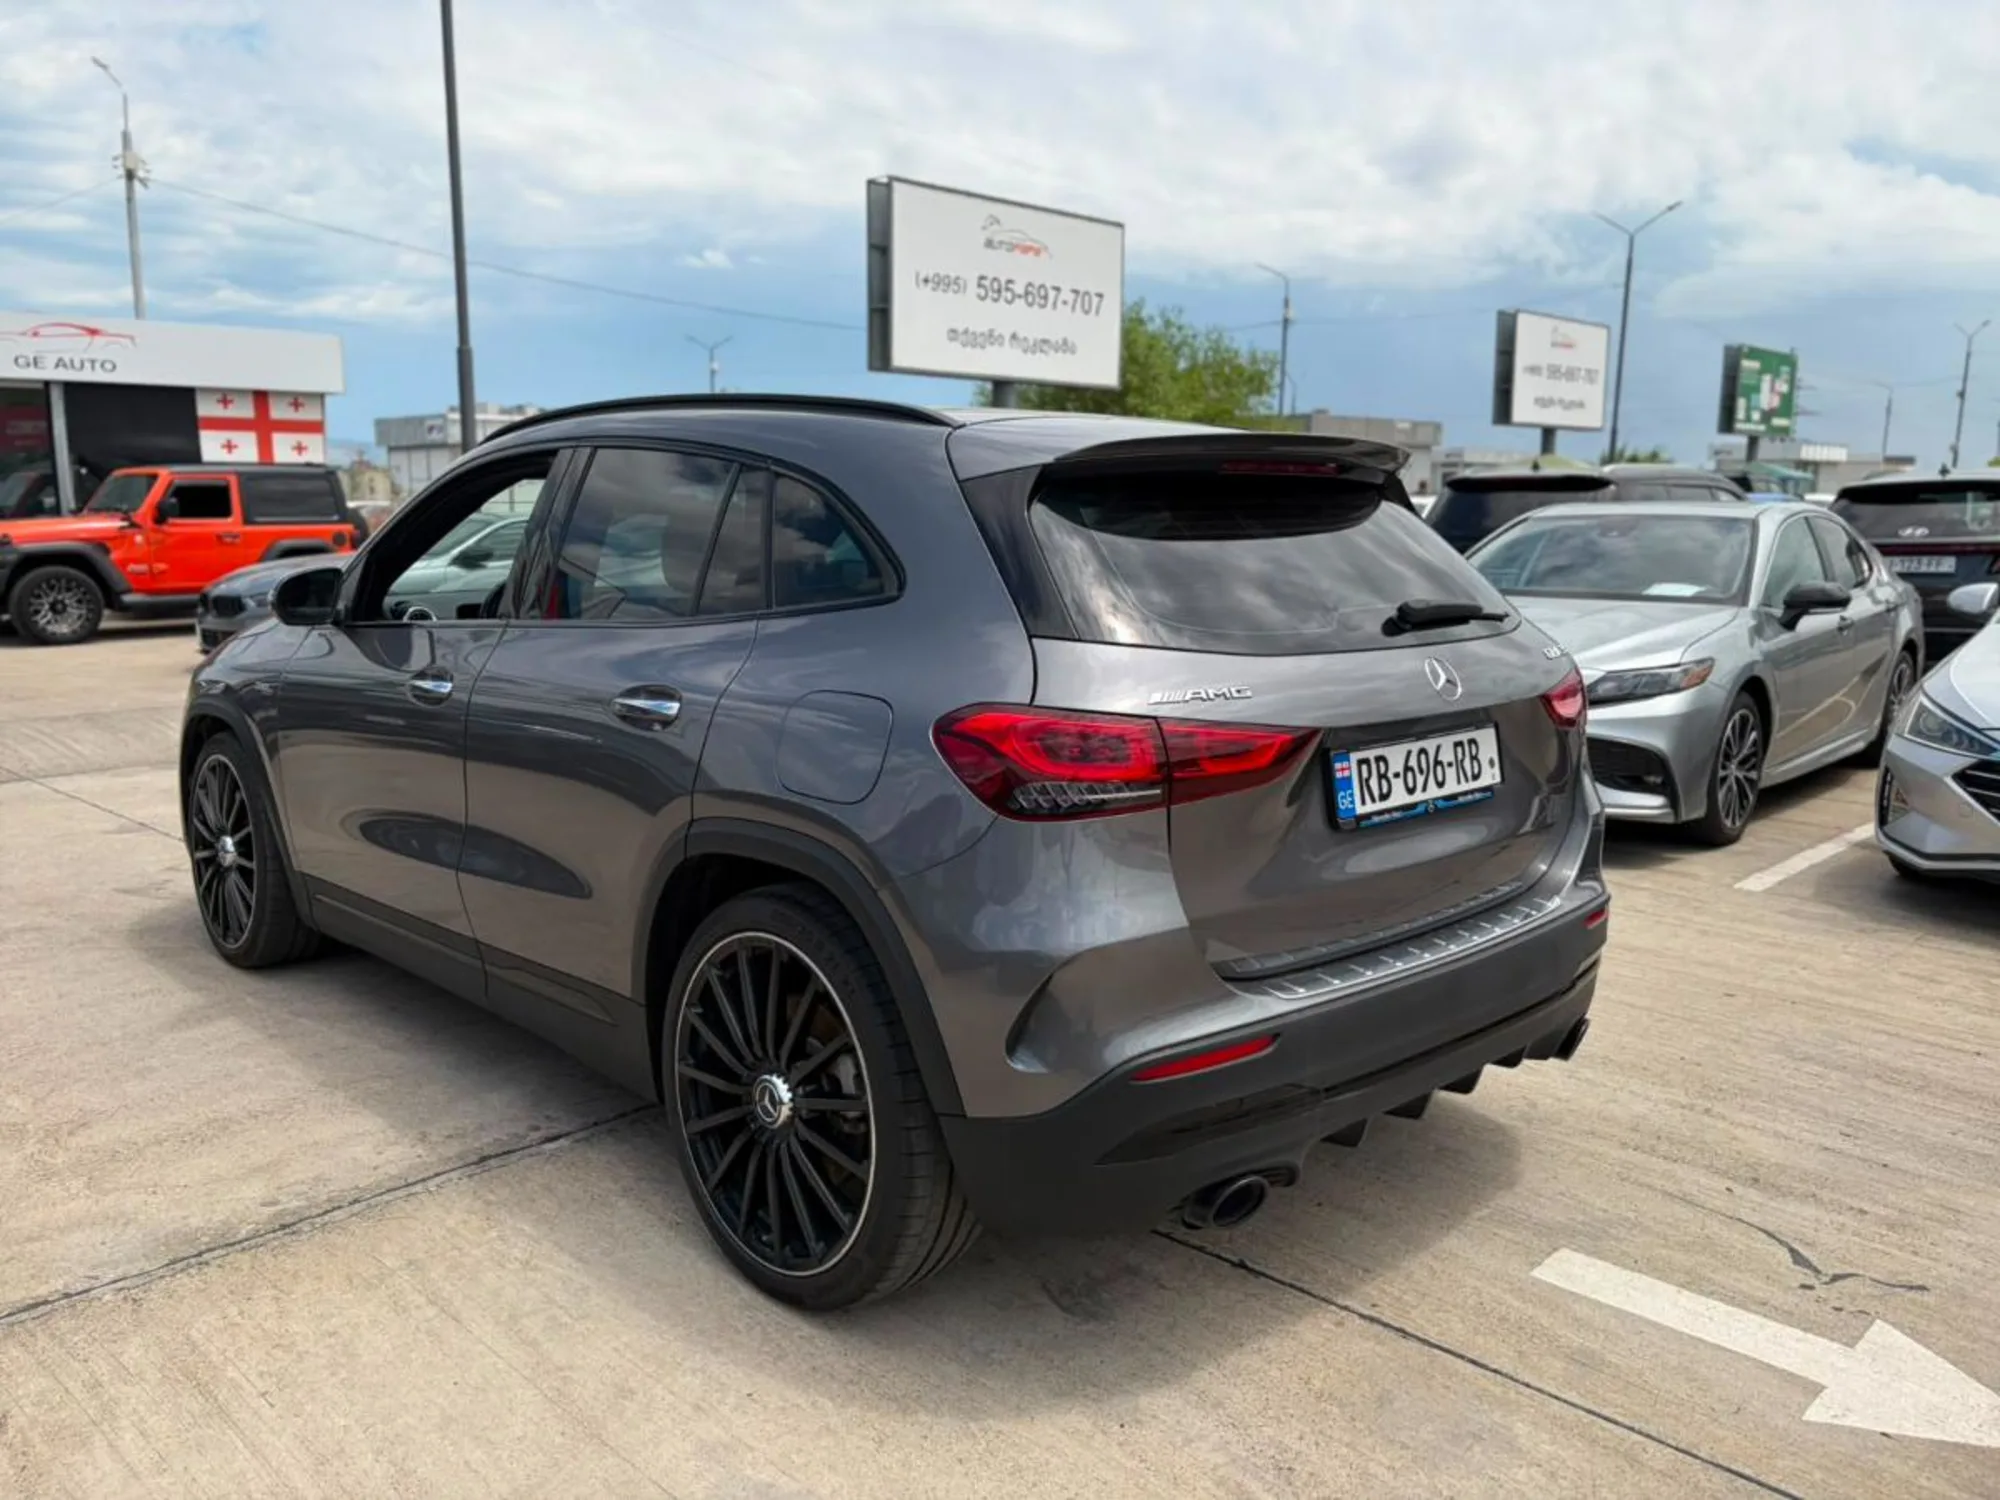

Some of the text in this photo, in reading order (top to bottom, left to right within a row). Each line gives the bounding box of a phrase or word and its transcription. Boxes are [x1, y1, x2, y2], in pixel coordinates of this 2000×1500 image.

[914, 271, 1104, 316] (+995) 595-697-707
[13, 355, 117, 373] GE AUTO
[1183, 686, 1253, 703] AMG
[1356, 737, 1482, 806] RB-696-RB
[1337, 789, 1354, 809] GE
